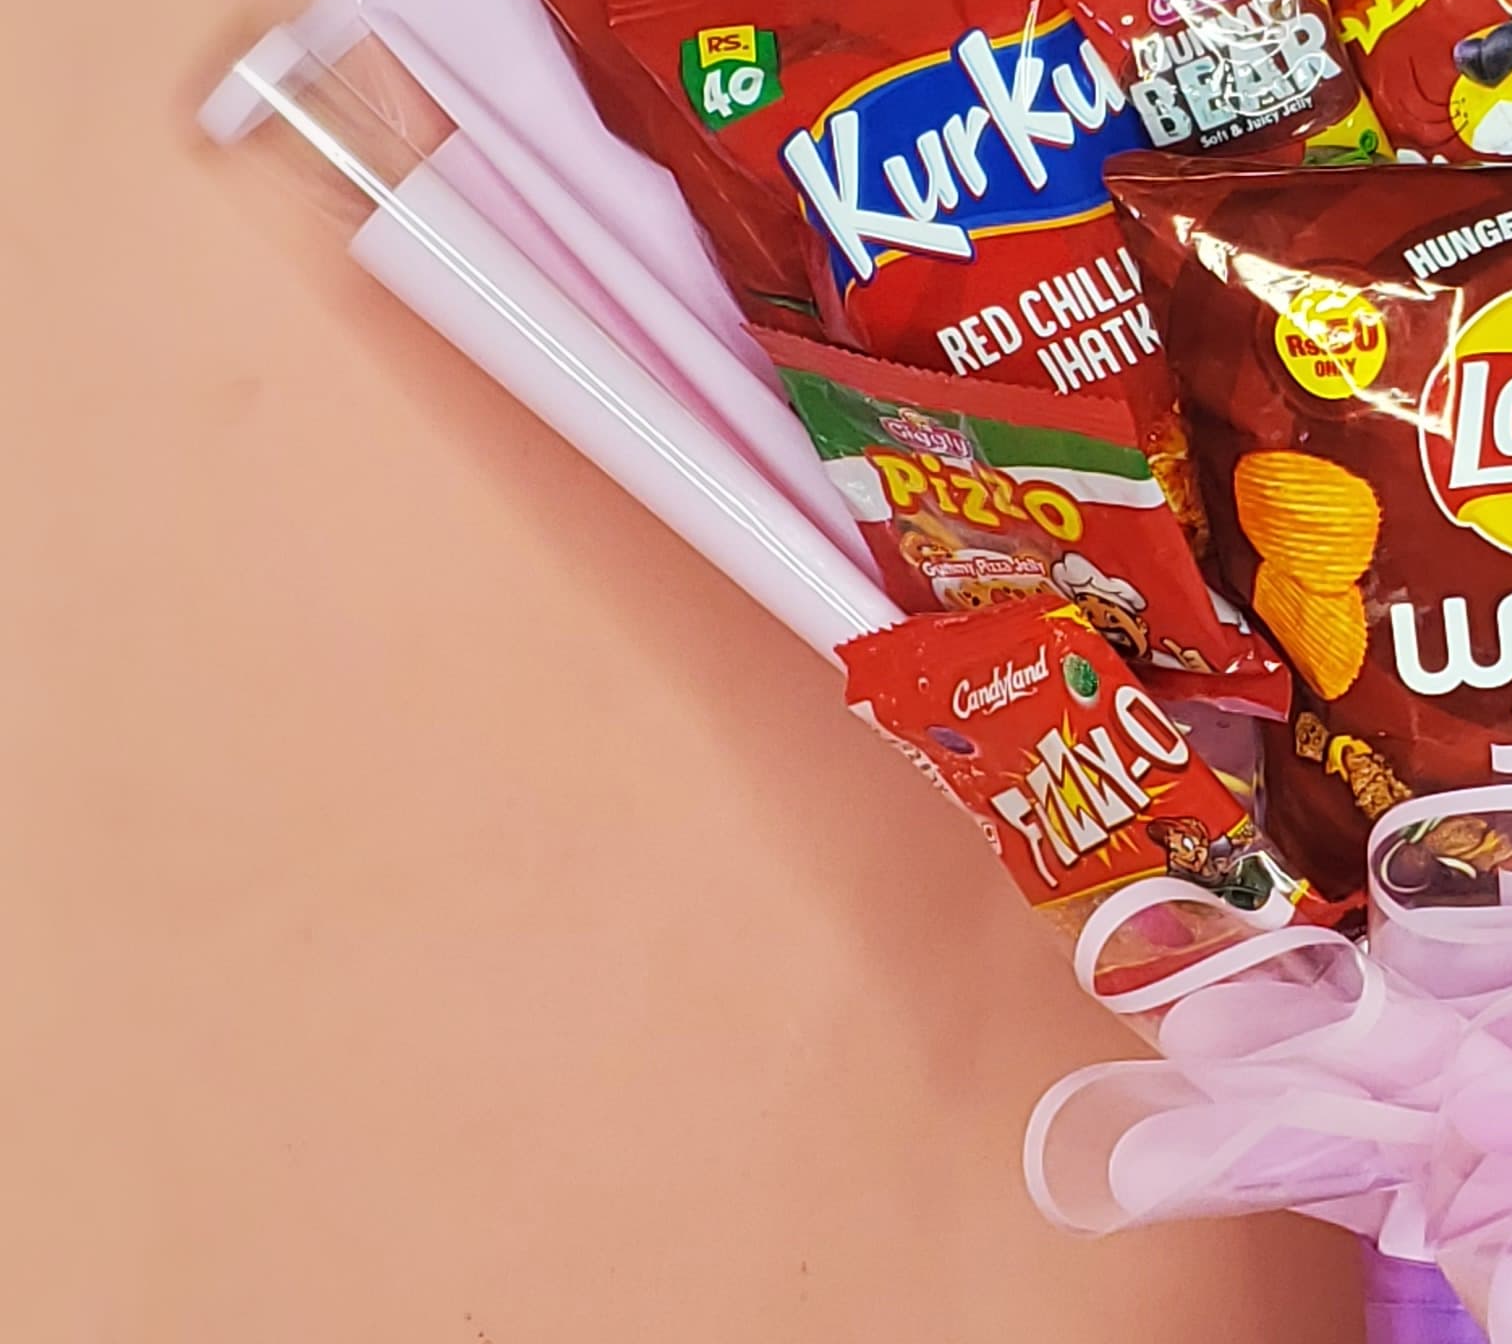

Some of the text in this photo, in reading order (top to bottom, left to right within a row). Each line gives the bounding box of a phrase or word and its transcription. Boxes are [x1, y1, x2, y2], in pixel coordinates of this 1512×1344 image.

[707, 34, 750, 54] RS.
[703, 66, 765, 118] 40
[1130, 13, 1341, 147] BEAR
[1201, 95, 1314, 149] Soft & Juicy Jelly
[784, 29, 1125, 280] Kurku
[936, 246, 1143, 377] RED CHILLI
[1314, 358, 1357, 378] ONY
[888, 421, 970, 458] Giggly
[976, 558, 1013, 575] Pizza
